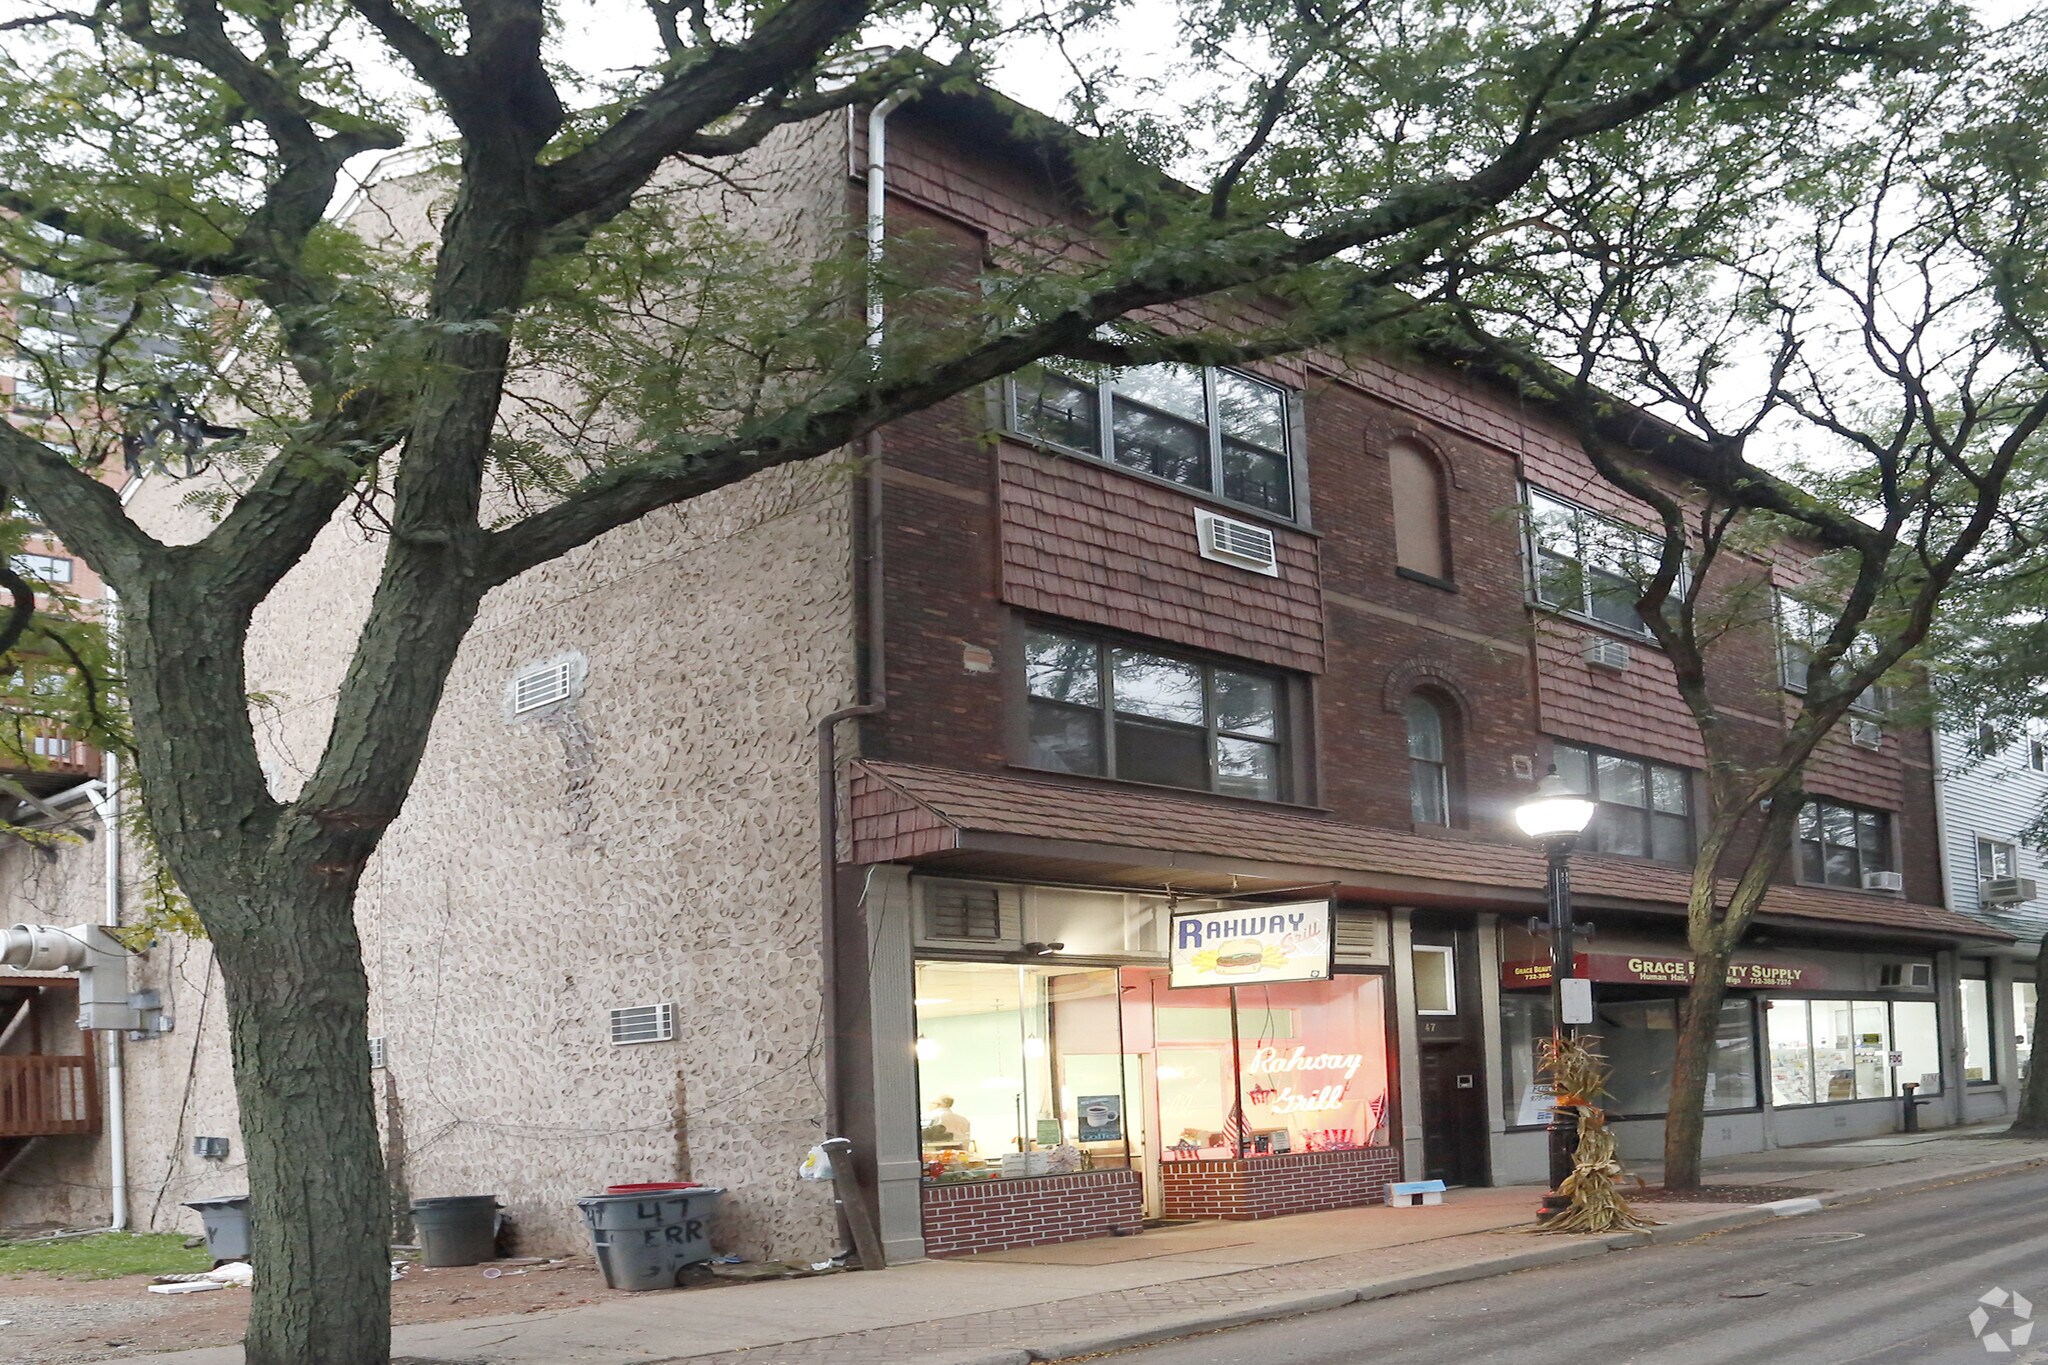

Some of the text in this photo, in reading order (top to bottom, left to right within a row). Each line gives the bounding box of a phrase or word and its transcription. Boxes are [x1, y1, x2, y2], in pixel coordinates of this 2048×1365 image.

[1179, 913, 1304, 949] RAHWAY
[1281, 922, 1321, 955] Grill
[1525, 972, 1552, 980] 732-388-
[1534, 965, 1552, 973] BEAUT
[1628, 958, 1802, 980] GRACE BTY SUPPLY
[1671, 974, 1688, 983] Hair,
[1424, 1023, 1436, 1032] 47
[1248, 1046, 1362, 1080] Rahway
[1271, 1084, 1344, 1113] Grill
[637, 1198, 689, 1225] 47
[643, 1220, 703, 1248] ERR
